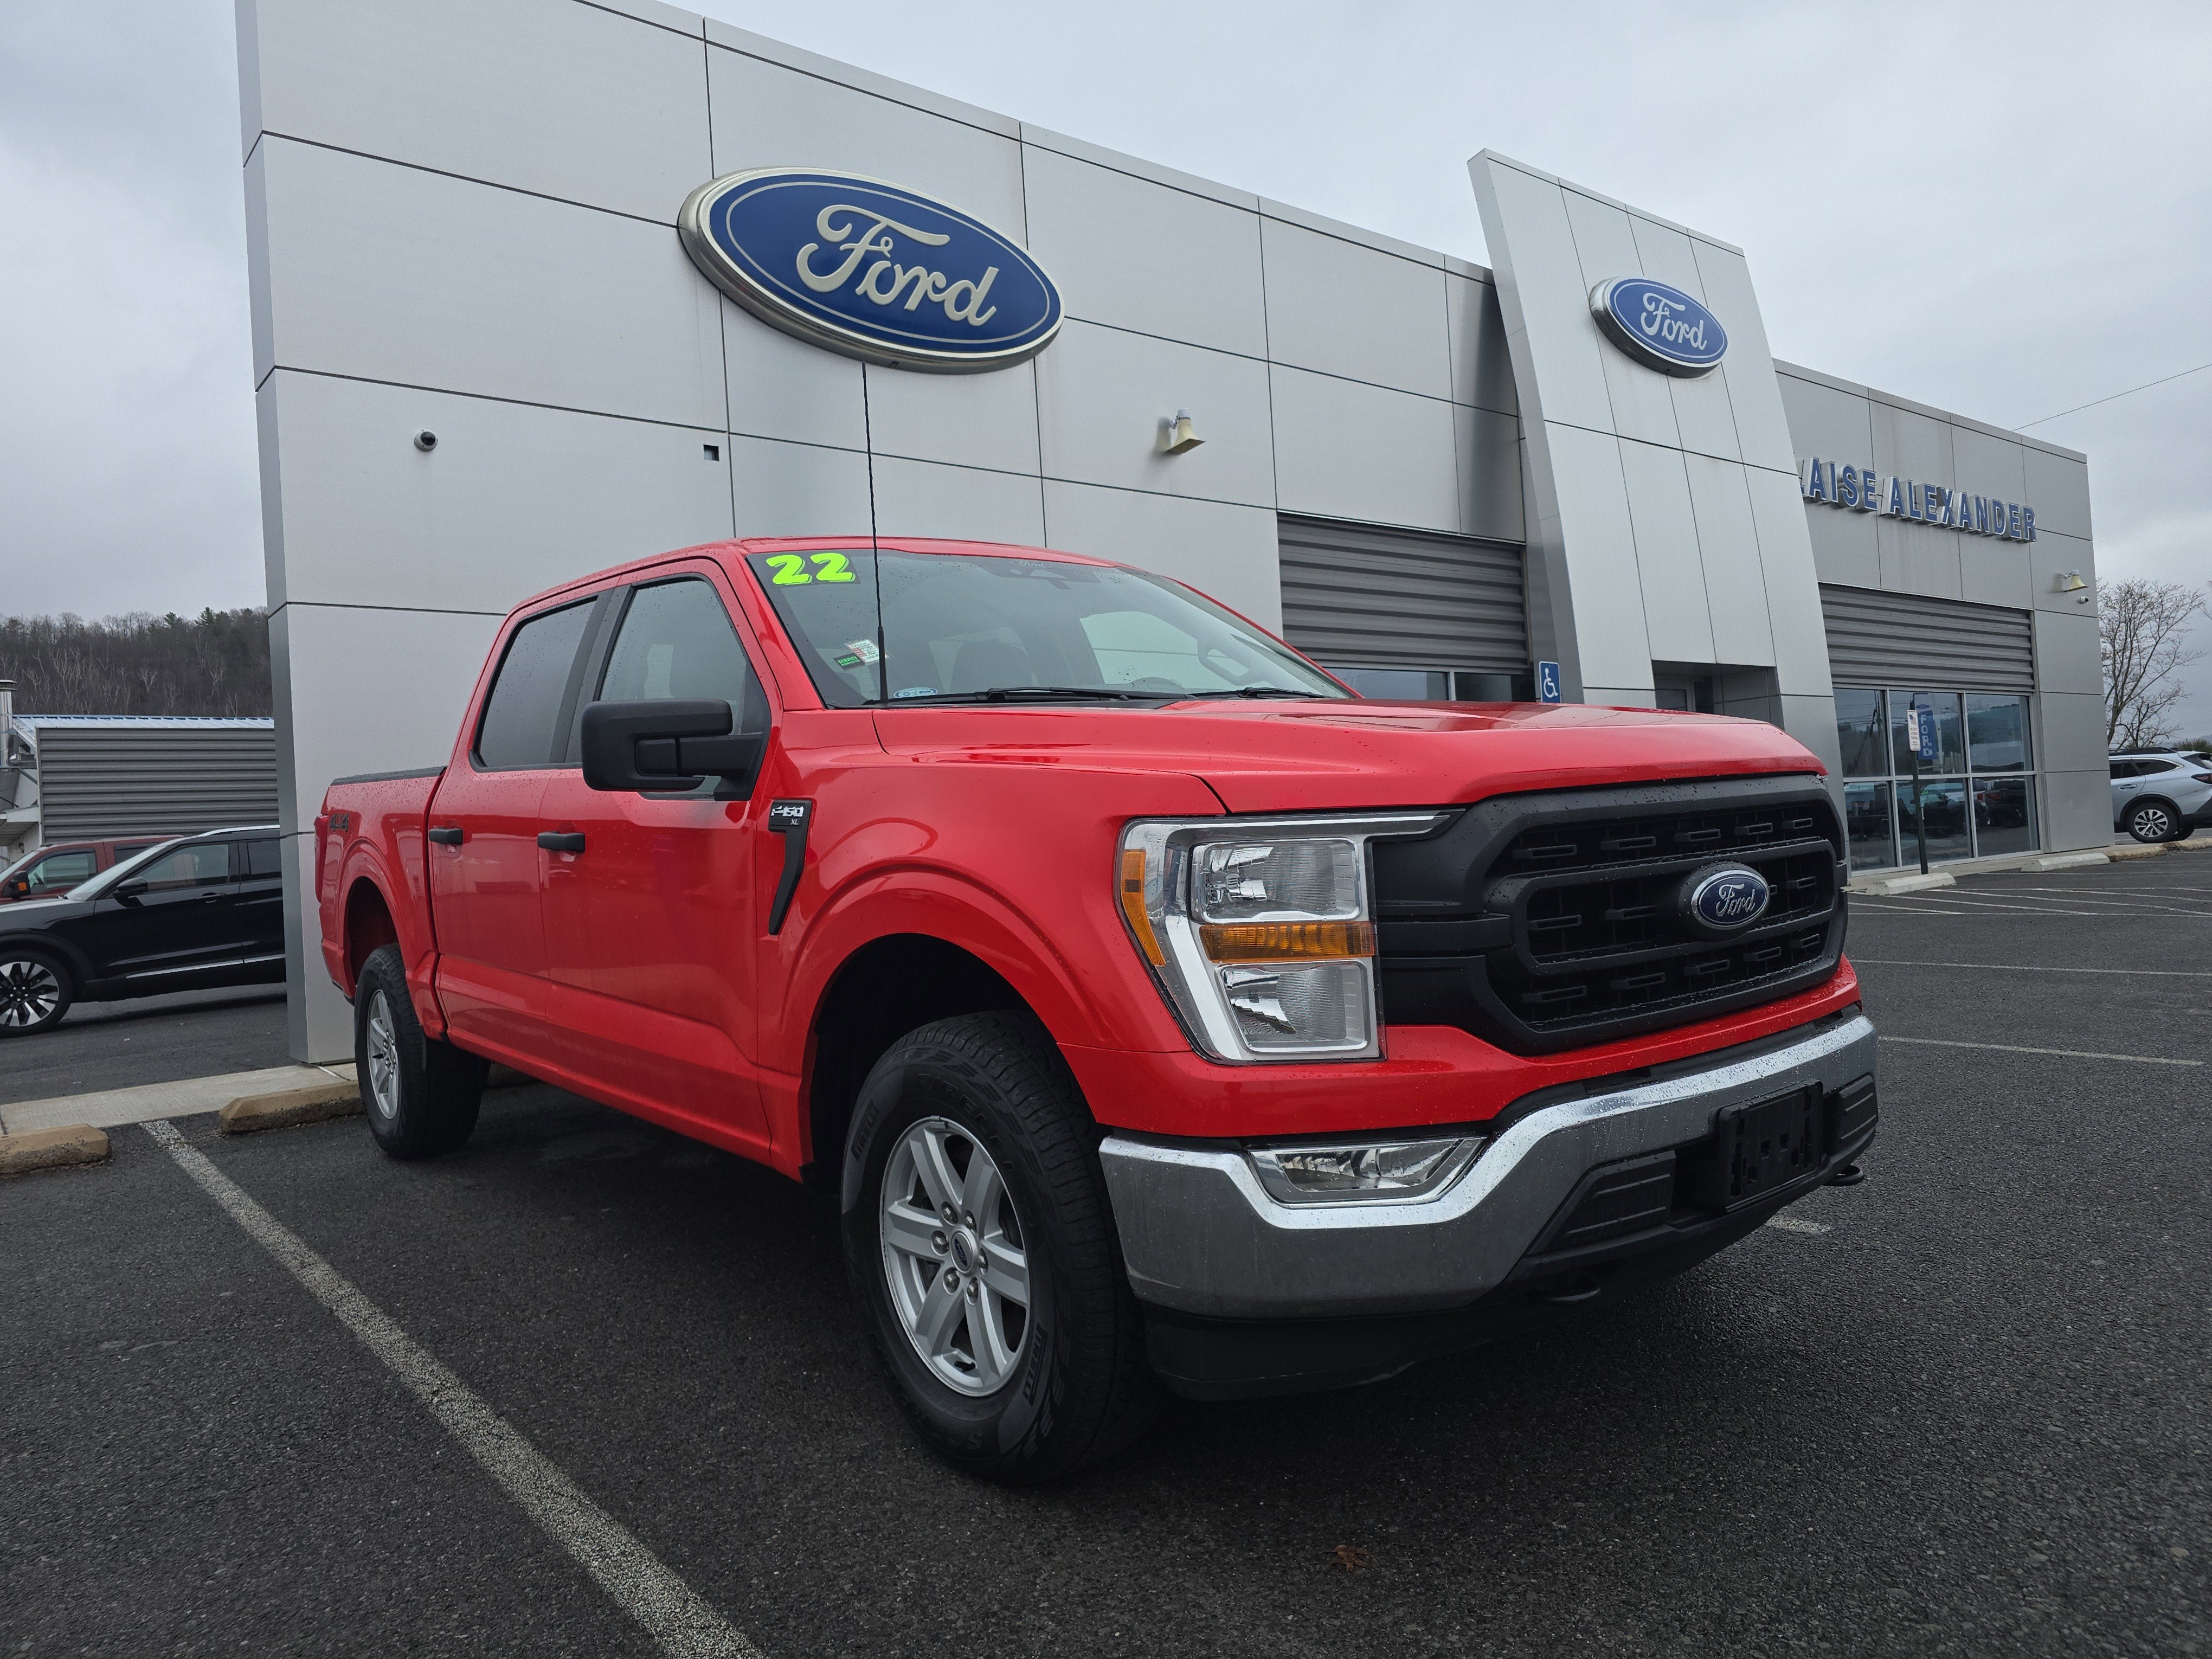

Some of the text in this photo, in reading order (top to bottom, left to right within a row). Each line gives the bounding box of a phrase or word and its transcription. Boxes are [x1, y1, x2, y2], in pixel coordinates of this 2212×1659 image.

[796, 204, 1000, 326] Ford
[1641, 293, 1707, 350] Ford
[1888, 475, 2037, 542] ALEXANDER
[766, 552, 856, 585] 22
[1716, 883, 1756, 916] Ford
[917, 1073, 1016, 1171] PIRELLI
[1023, 1322, 1048, 1405] PIRELLI
